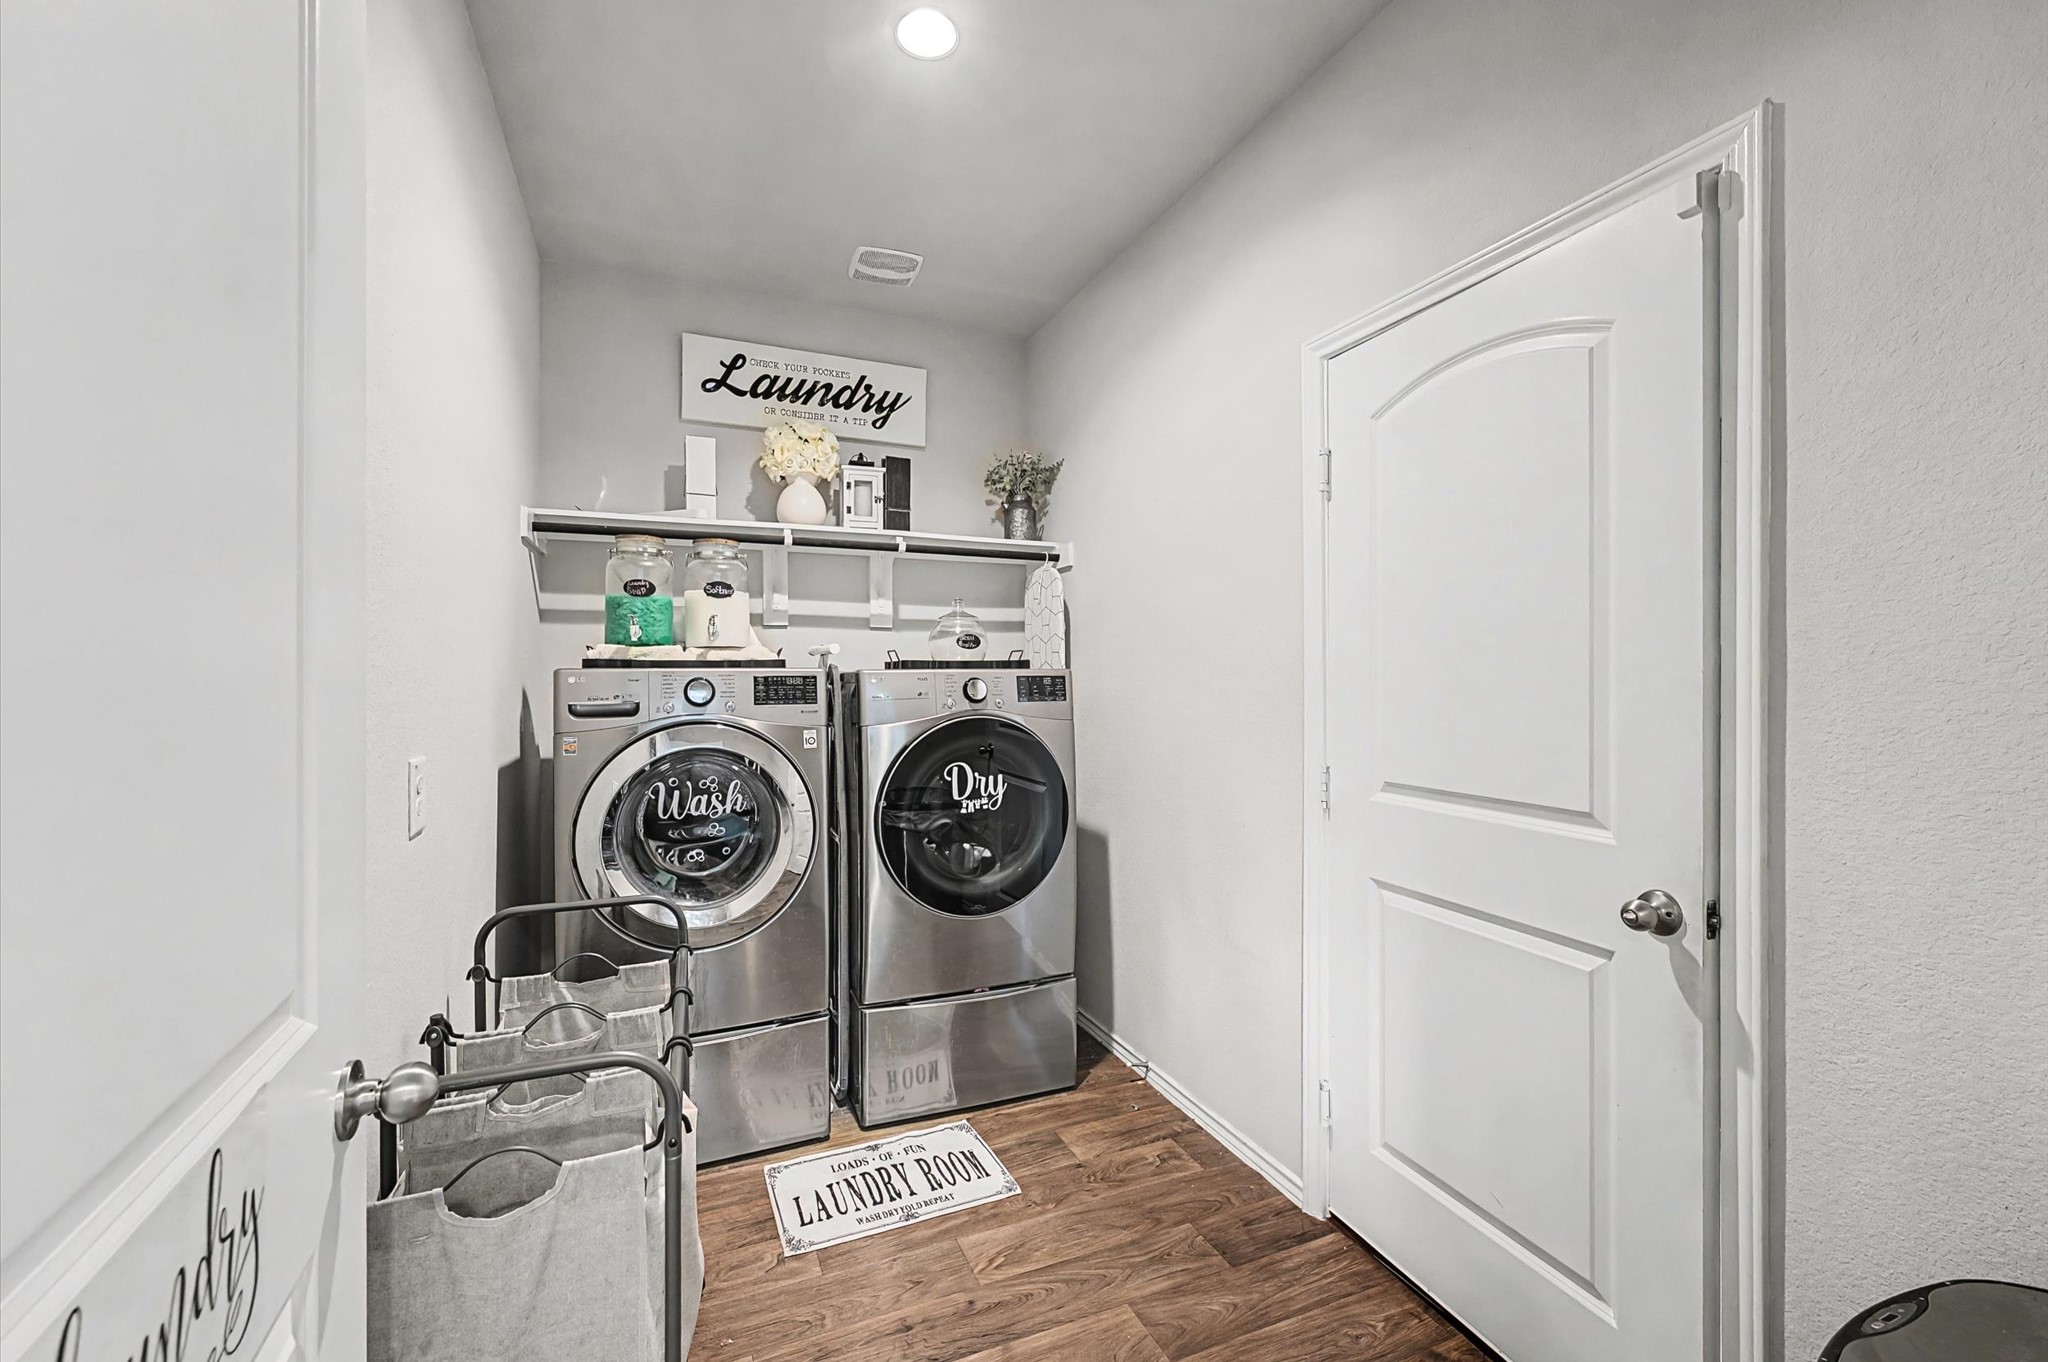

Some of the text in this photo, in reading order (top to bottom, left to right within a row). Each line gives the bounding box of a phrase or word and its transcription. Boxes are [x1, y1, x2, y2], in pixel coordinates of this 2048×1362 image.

[750, 358, 851, 380] CHECK YOUR POCKETS
[701, 353, 913, 430] Laundry
[764, 406, 869, 427] OR CONSIDER IT A TIP
[647, 779, 747, 819] Wash
[943, 762, 1008, 811] Dry
[830, 1143, 927, 1174] LOADS OF FUN
[792, 1148, 993, 1228] LAUNDRY ROOM
[855, 1192, 956, 1225] WASH DRY FOLD REPEAT
